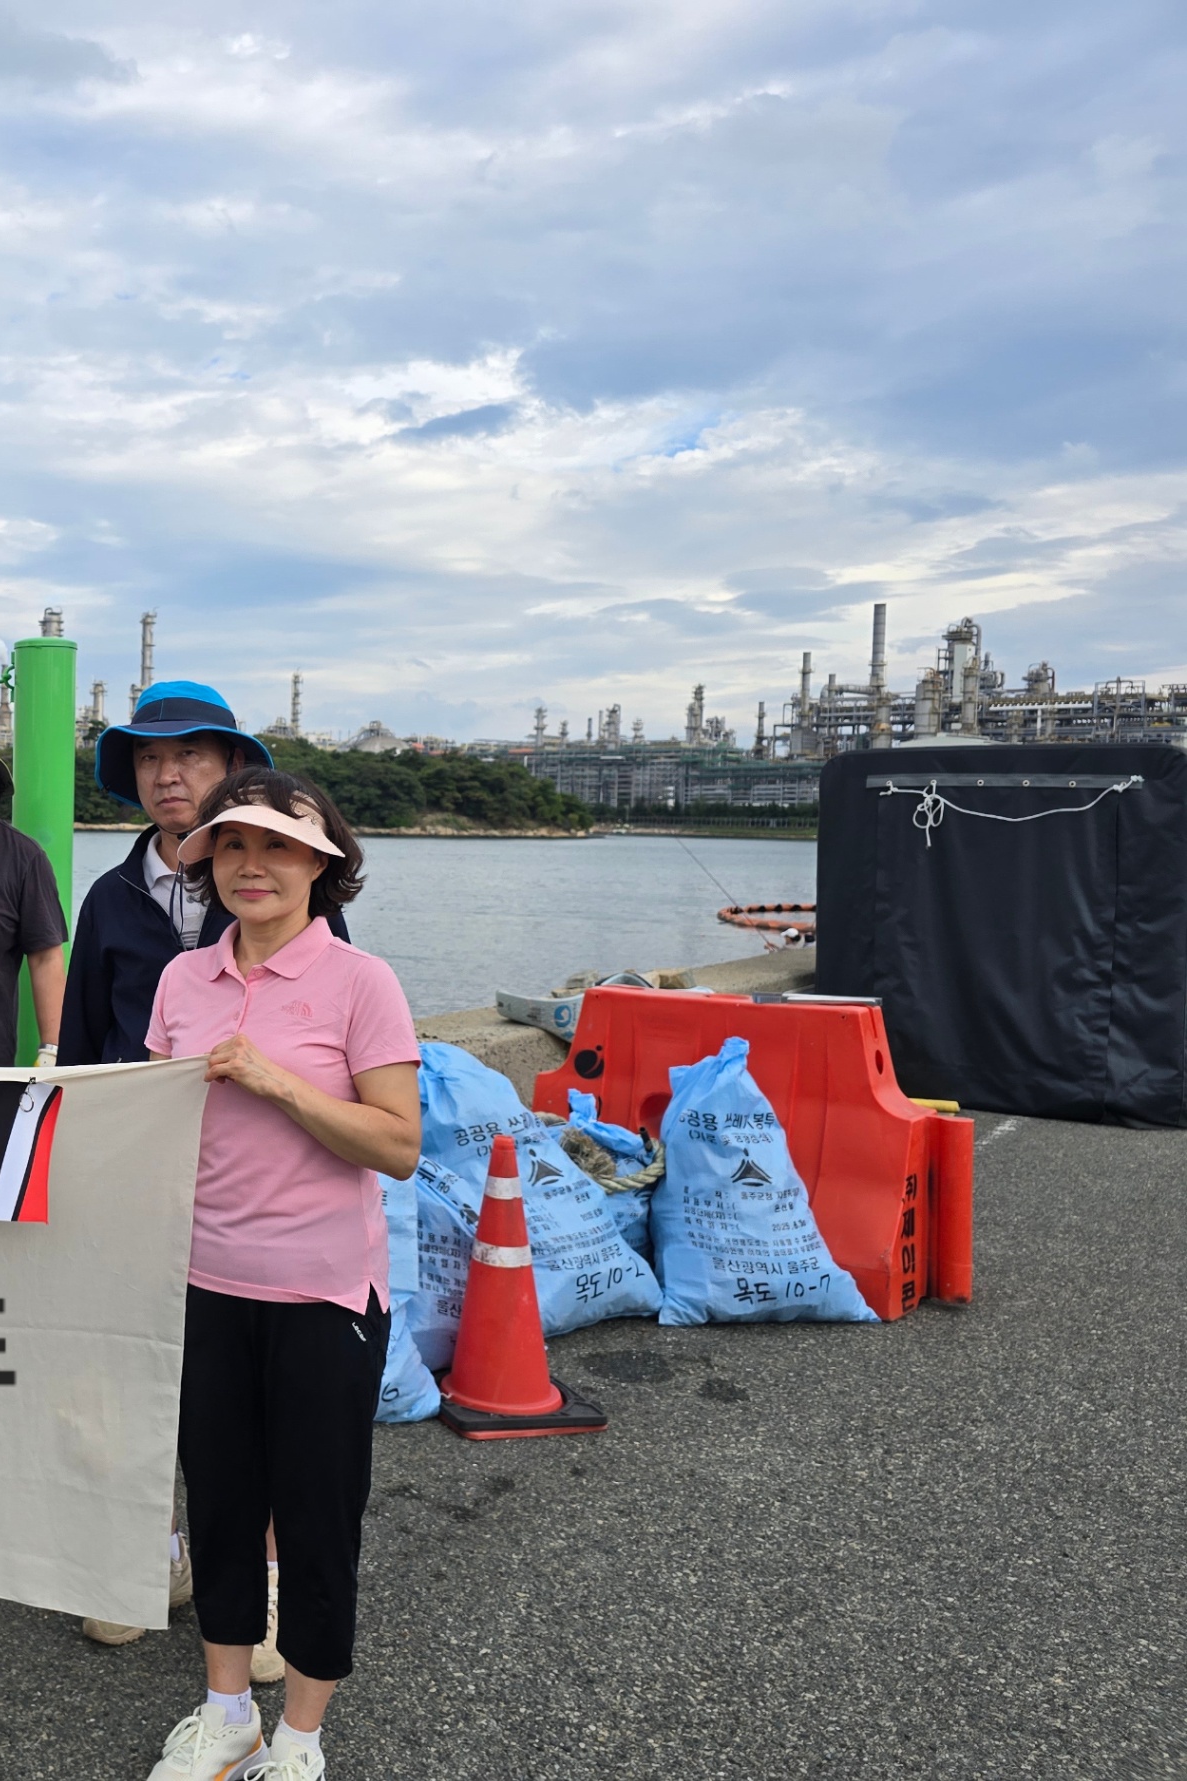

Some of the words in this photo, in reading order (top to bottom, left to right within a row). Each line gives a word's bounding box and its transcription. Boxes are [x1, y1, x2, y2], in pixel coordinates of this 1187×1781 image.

[712, 1256, 783, 1275] 울산광역시
[787, 1256, 820, 1274] 울주군
[733, 1277, 777, 1304] 목도
[785, 1273, 830, 1298] 10-7
